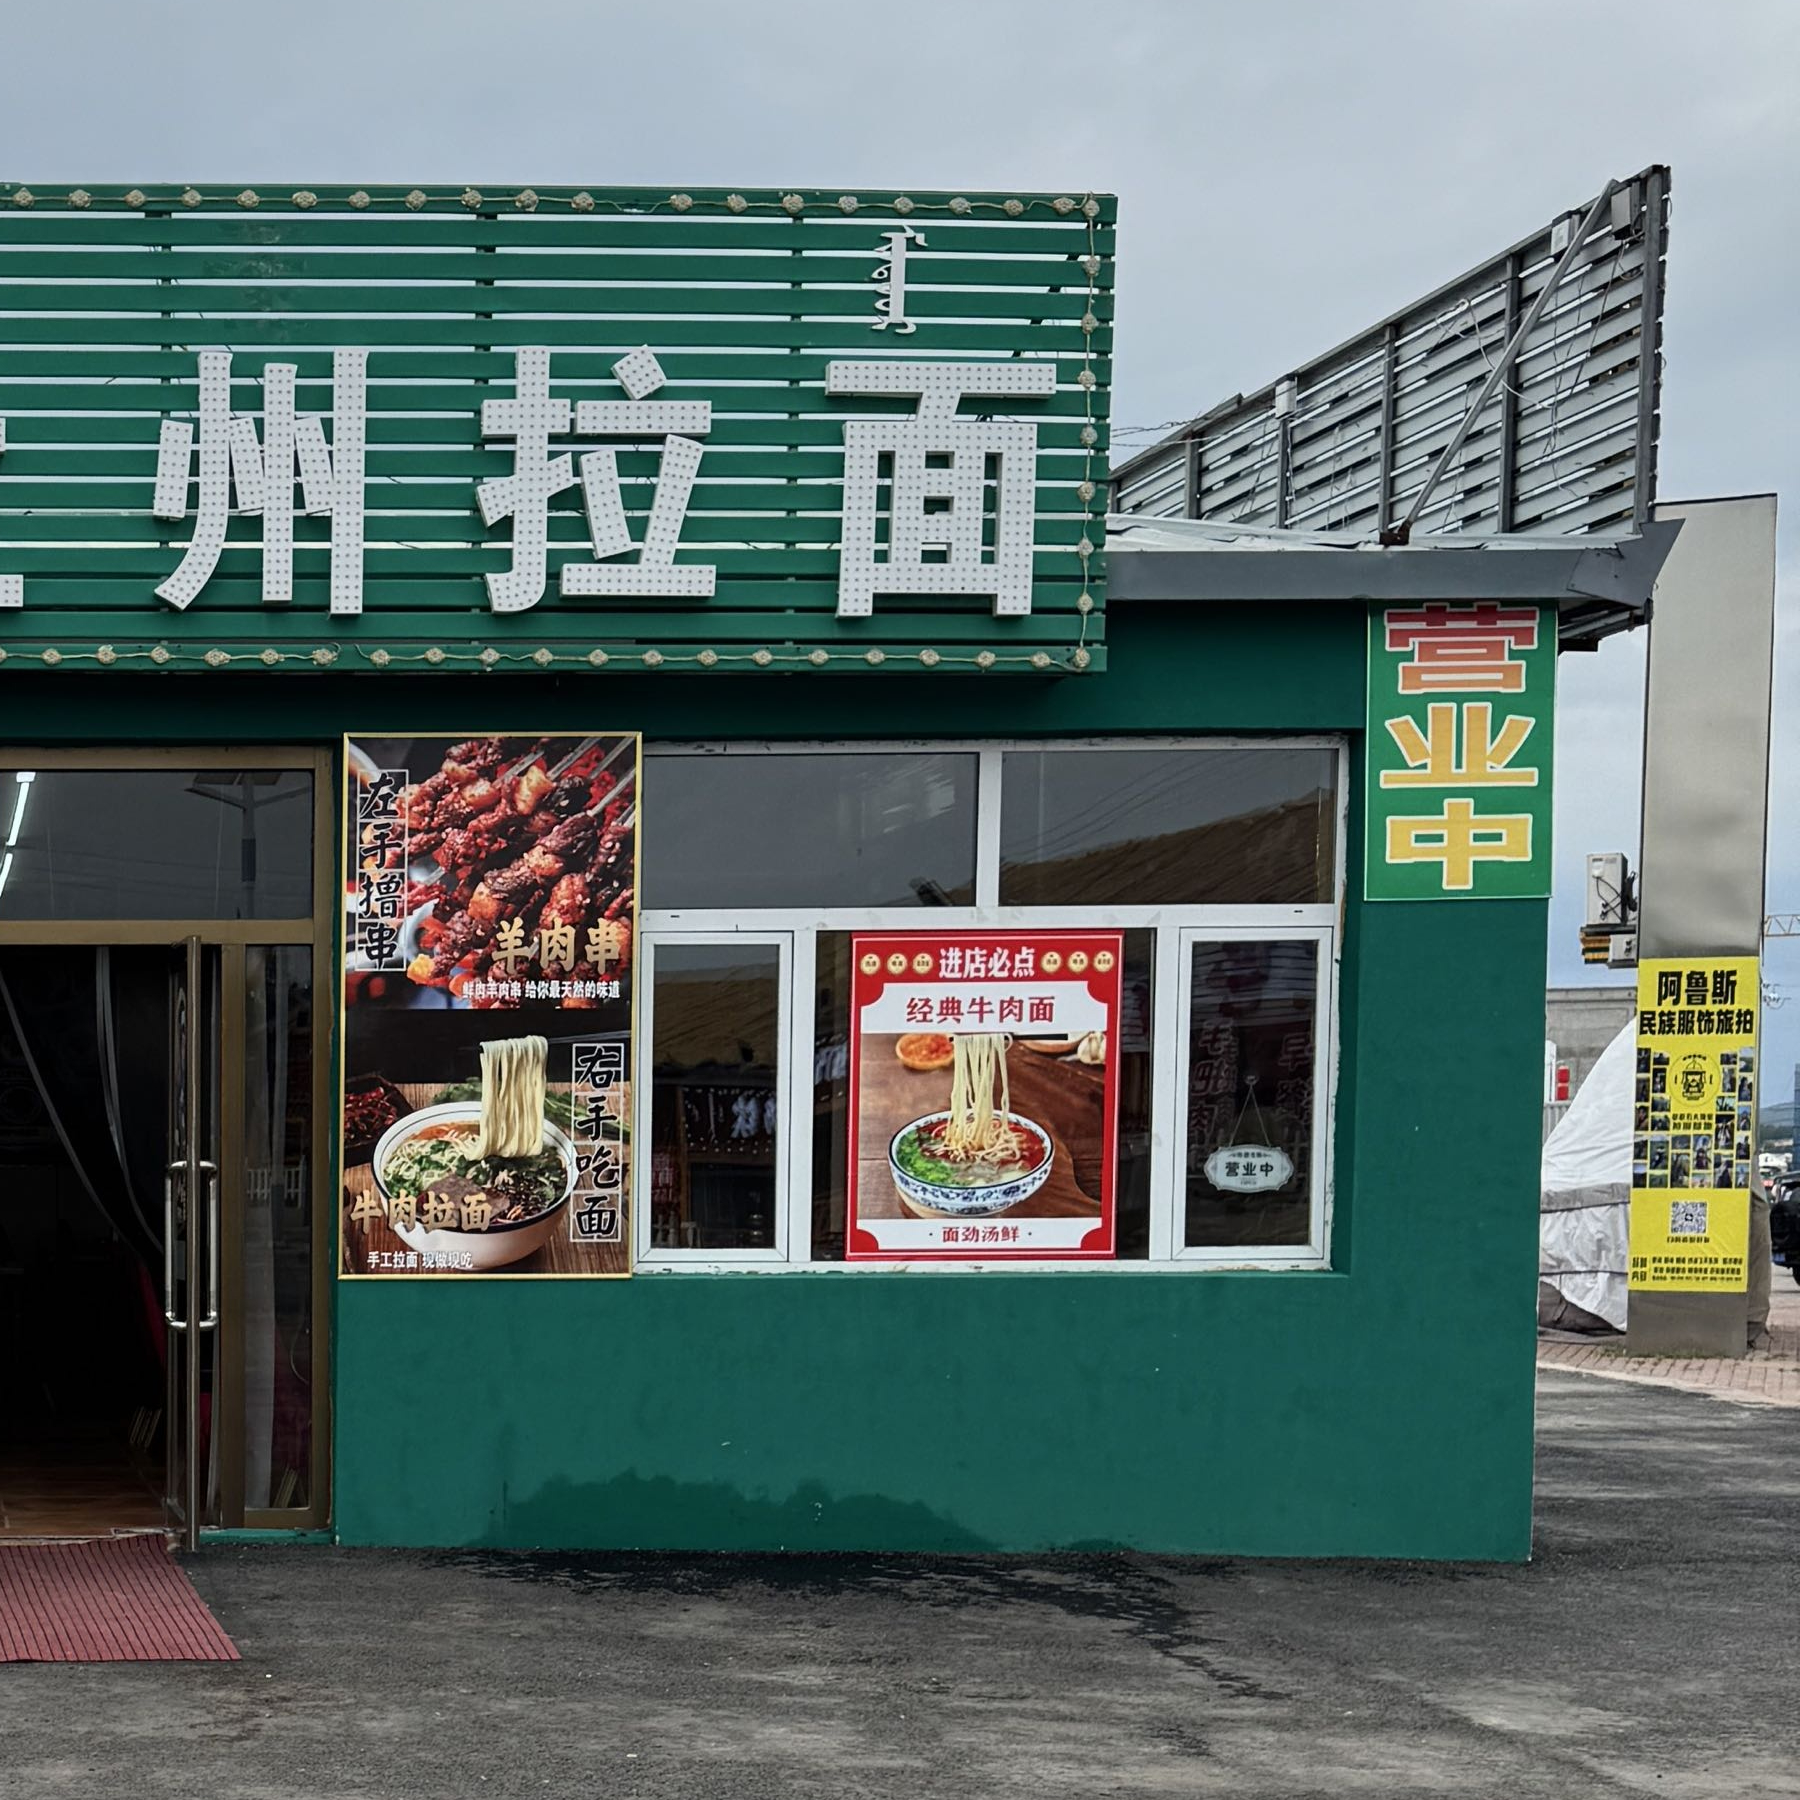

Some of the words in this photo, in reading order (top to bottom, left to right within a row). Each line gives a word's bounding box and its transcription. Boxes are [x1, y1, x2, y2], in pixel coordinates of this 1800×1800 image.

[1380, 602, 1539, 890] 营业中
[358, 773, 405, 971] 左手撸串
[492, 917, 621, 976] 羊肉串
[938, 946, 1035, 978] 进店必点
[525, 980, 621, 999] 给你最天然的味道
[1657, 969, 1738, 1007] 阿鲁斯
[906, 995, 1056, 1025] 经典牛肉面
[1639, 1008, 1755, 1036] 民族服饰旅拍
[576, 1047, 621, 1238] 右手吃面
[1225, 1161, 1274, 1177] 营业中
[351, 1189, 493, 1236] 牛肉拉面
[942, 1226, 1021, 1243] 面劲汤鲜
[367, 1251, 419, 1269] 手工拉面
[422, 1251, 474, 1269] 现做现吃
